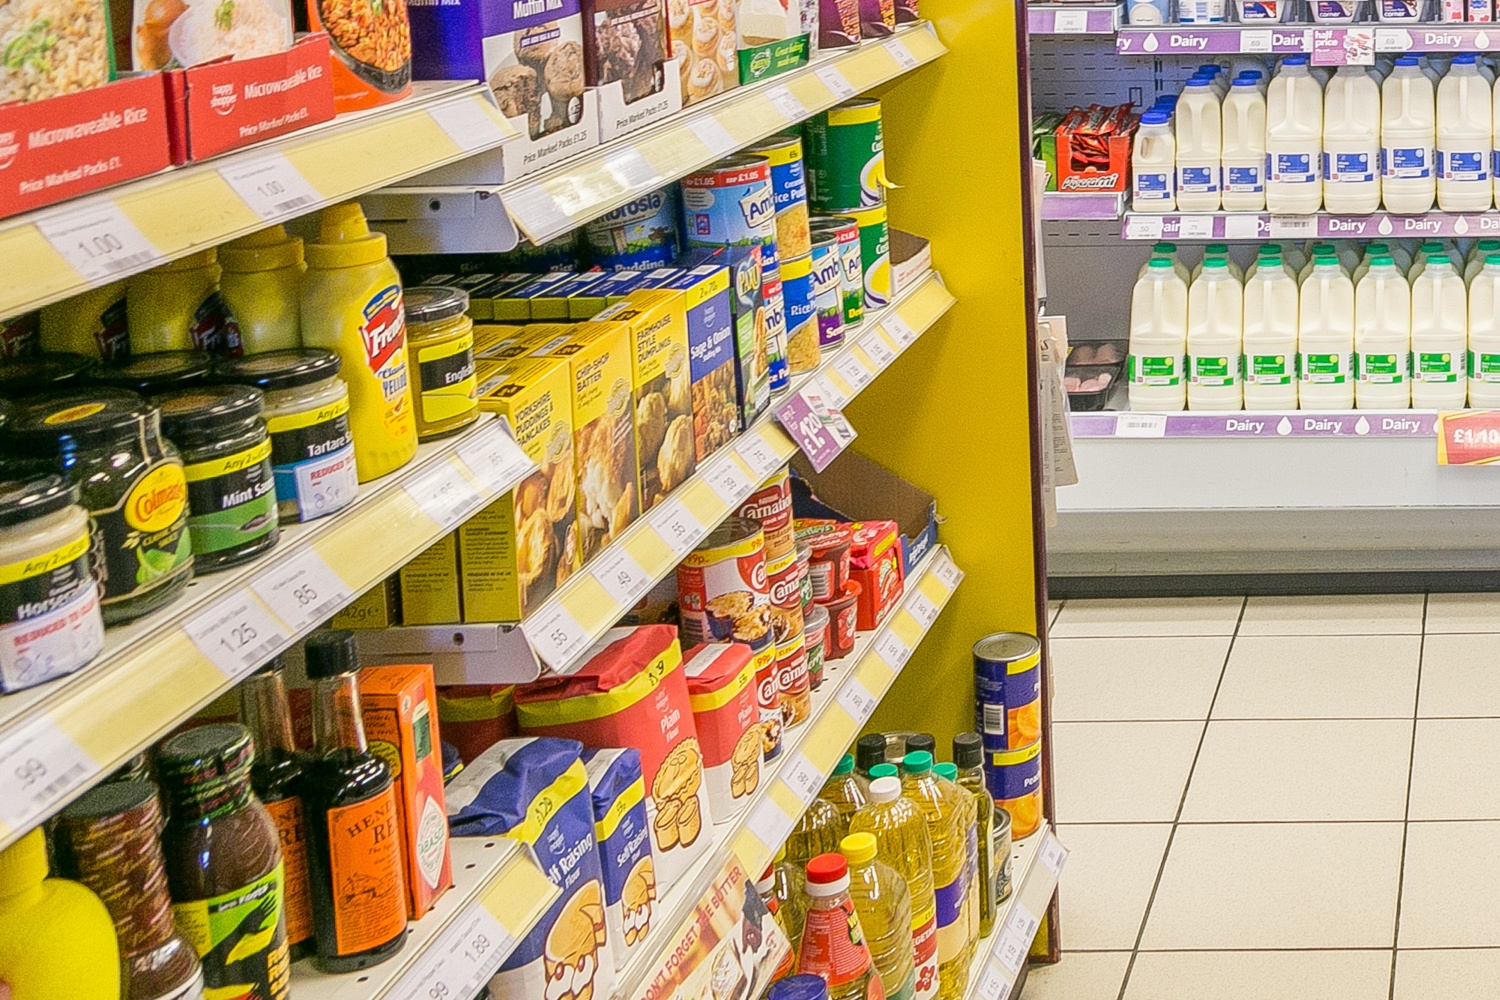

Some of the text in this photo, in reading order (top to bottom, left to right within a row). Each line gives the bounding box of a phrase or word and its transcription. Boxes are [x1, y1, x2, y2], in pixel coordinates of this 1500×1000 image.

[1170, 35, 1208, 49] Dairy
[1315, 31, 1333, 39] half
[1315, 38, 1338, 48] price
[244, 64, 323, 100] Microwaveable Rice
[28, 105, 148, 150] Microwaveable Rice
[1328, 218, 1366, 233] Dairy
[78, 233, 123, 261] 1.00
[636, 313, 672, 342] FARMHOUSE
[637, 335, 657, 352] STYLE
[637, 336, 672, 364] DUMPLINGS
[575, 351, 610, 380] CHIP-SHOP
[576, 371, 603, 393] BATTER
[514, 391, 551, 422] YORKSHIRE
[515, 405, 549, 436] PUDDINGS
[1226, 419, 1264, 433] Dairy
[307, 436, 344, 457] Tartare
[1453, 428, 1499, 444] £1.10
[310, 462, 344, 480] REDUCED
[222, 489, 252, 509] Mint
[219, 622, 257, 653] 1.25
[660, 708, 681, 734] Plain
[559, 832, 593, 873] Raising
[564, 868, 581, 889] Flour
[665, 929, 699, 975] FORGET
[699, 905, 715, 932] THE
[711, 866, 742, 909] BUTTER
[463, 934, 491, 962] 1.89
